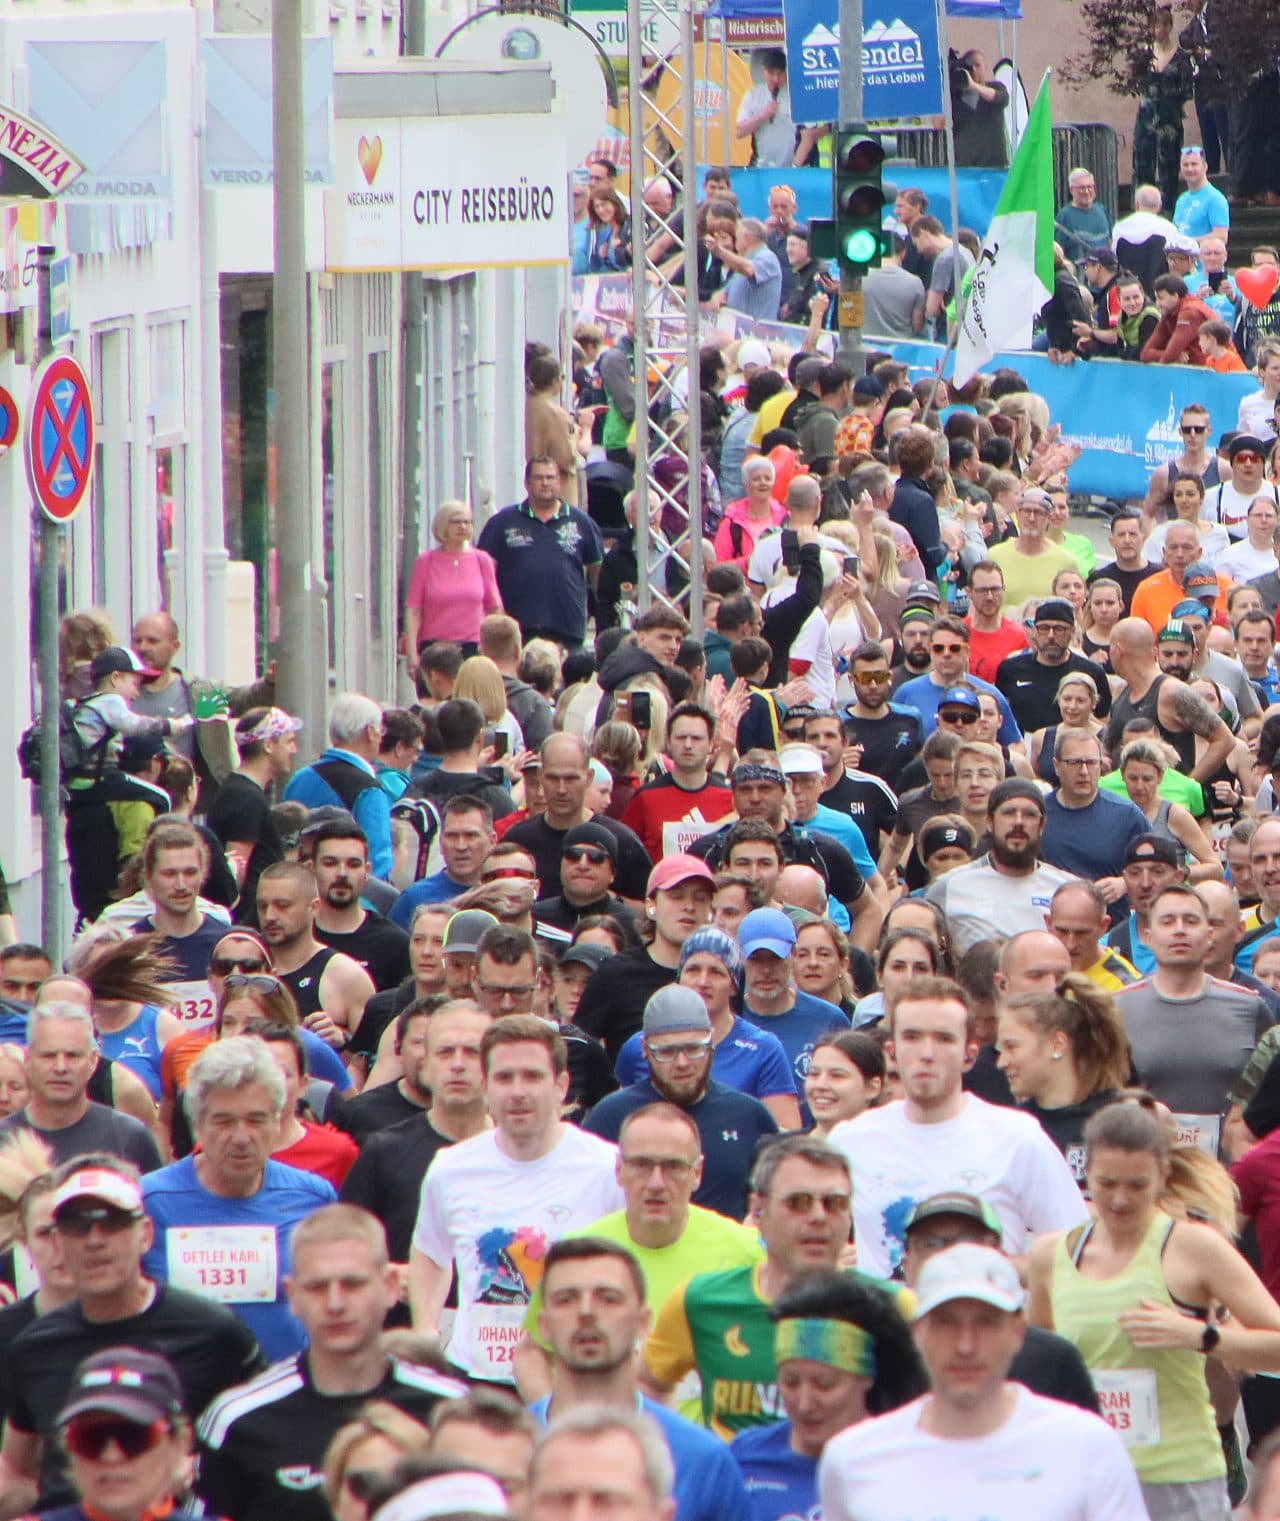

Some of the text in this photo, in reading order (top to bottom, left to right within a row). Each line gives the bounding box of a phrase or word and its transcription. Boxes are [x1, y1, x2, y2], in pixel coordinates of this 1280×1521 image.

[803, 40, 923, 69] St. endel
[816, 77, 840, 89] hier
[868, 73, 887, 86] das
[891, 71, 925, 83] Leben
[0, 115, 71, 187] NEZIA
[210, 169, 262, 183] VERO
[94, 182, 156, 195] MODA
[346, 191, 394, 206] NECKERMANN
[413, 175, 554, 225] CITY REISEBÜRO
[850, 801, 866, 815] SH
[183, 1250, 261, 1263] DETLEF KARL
[197, 1268, 247, 1285] 1331
